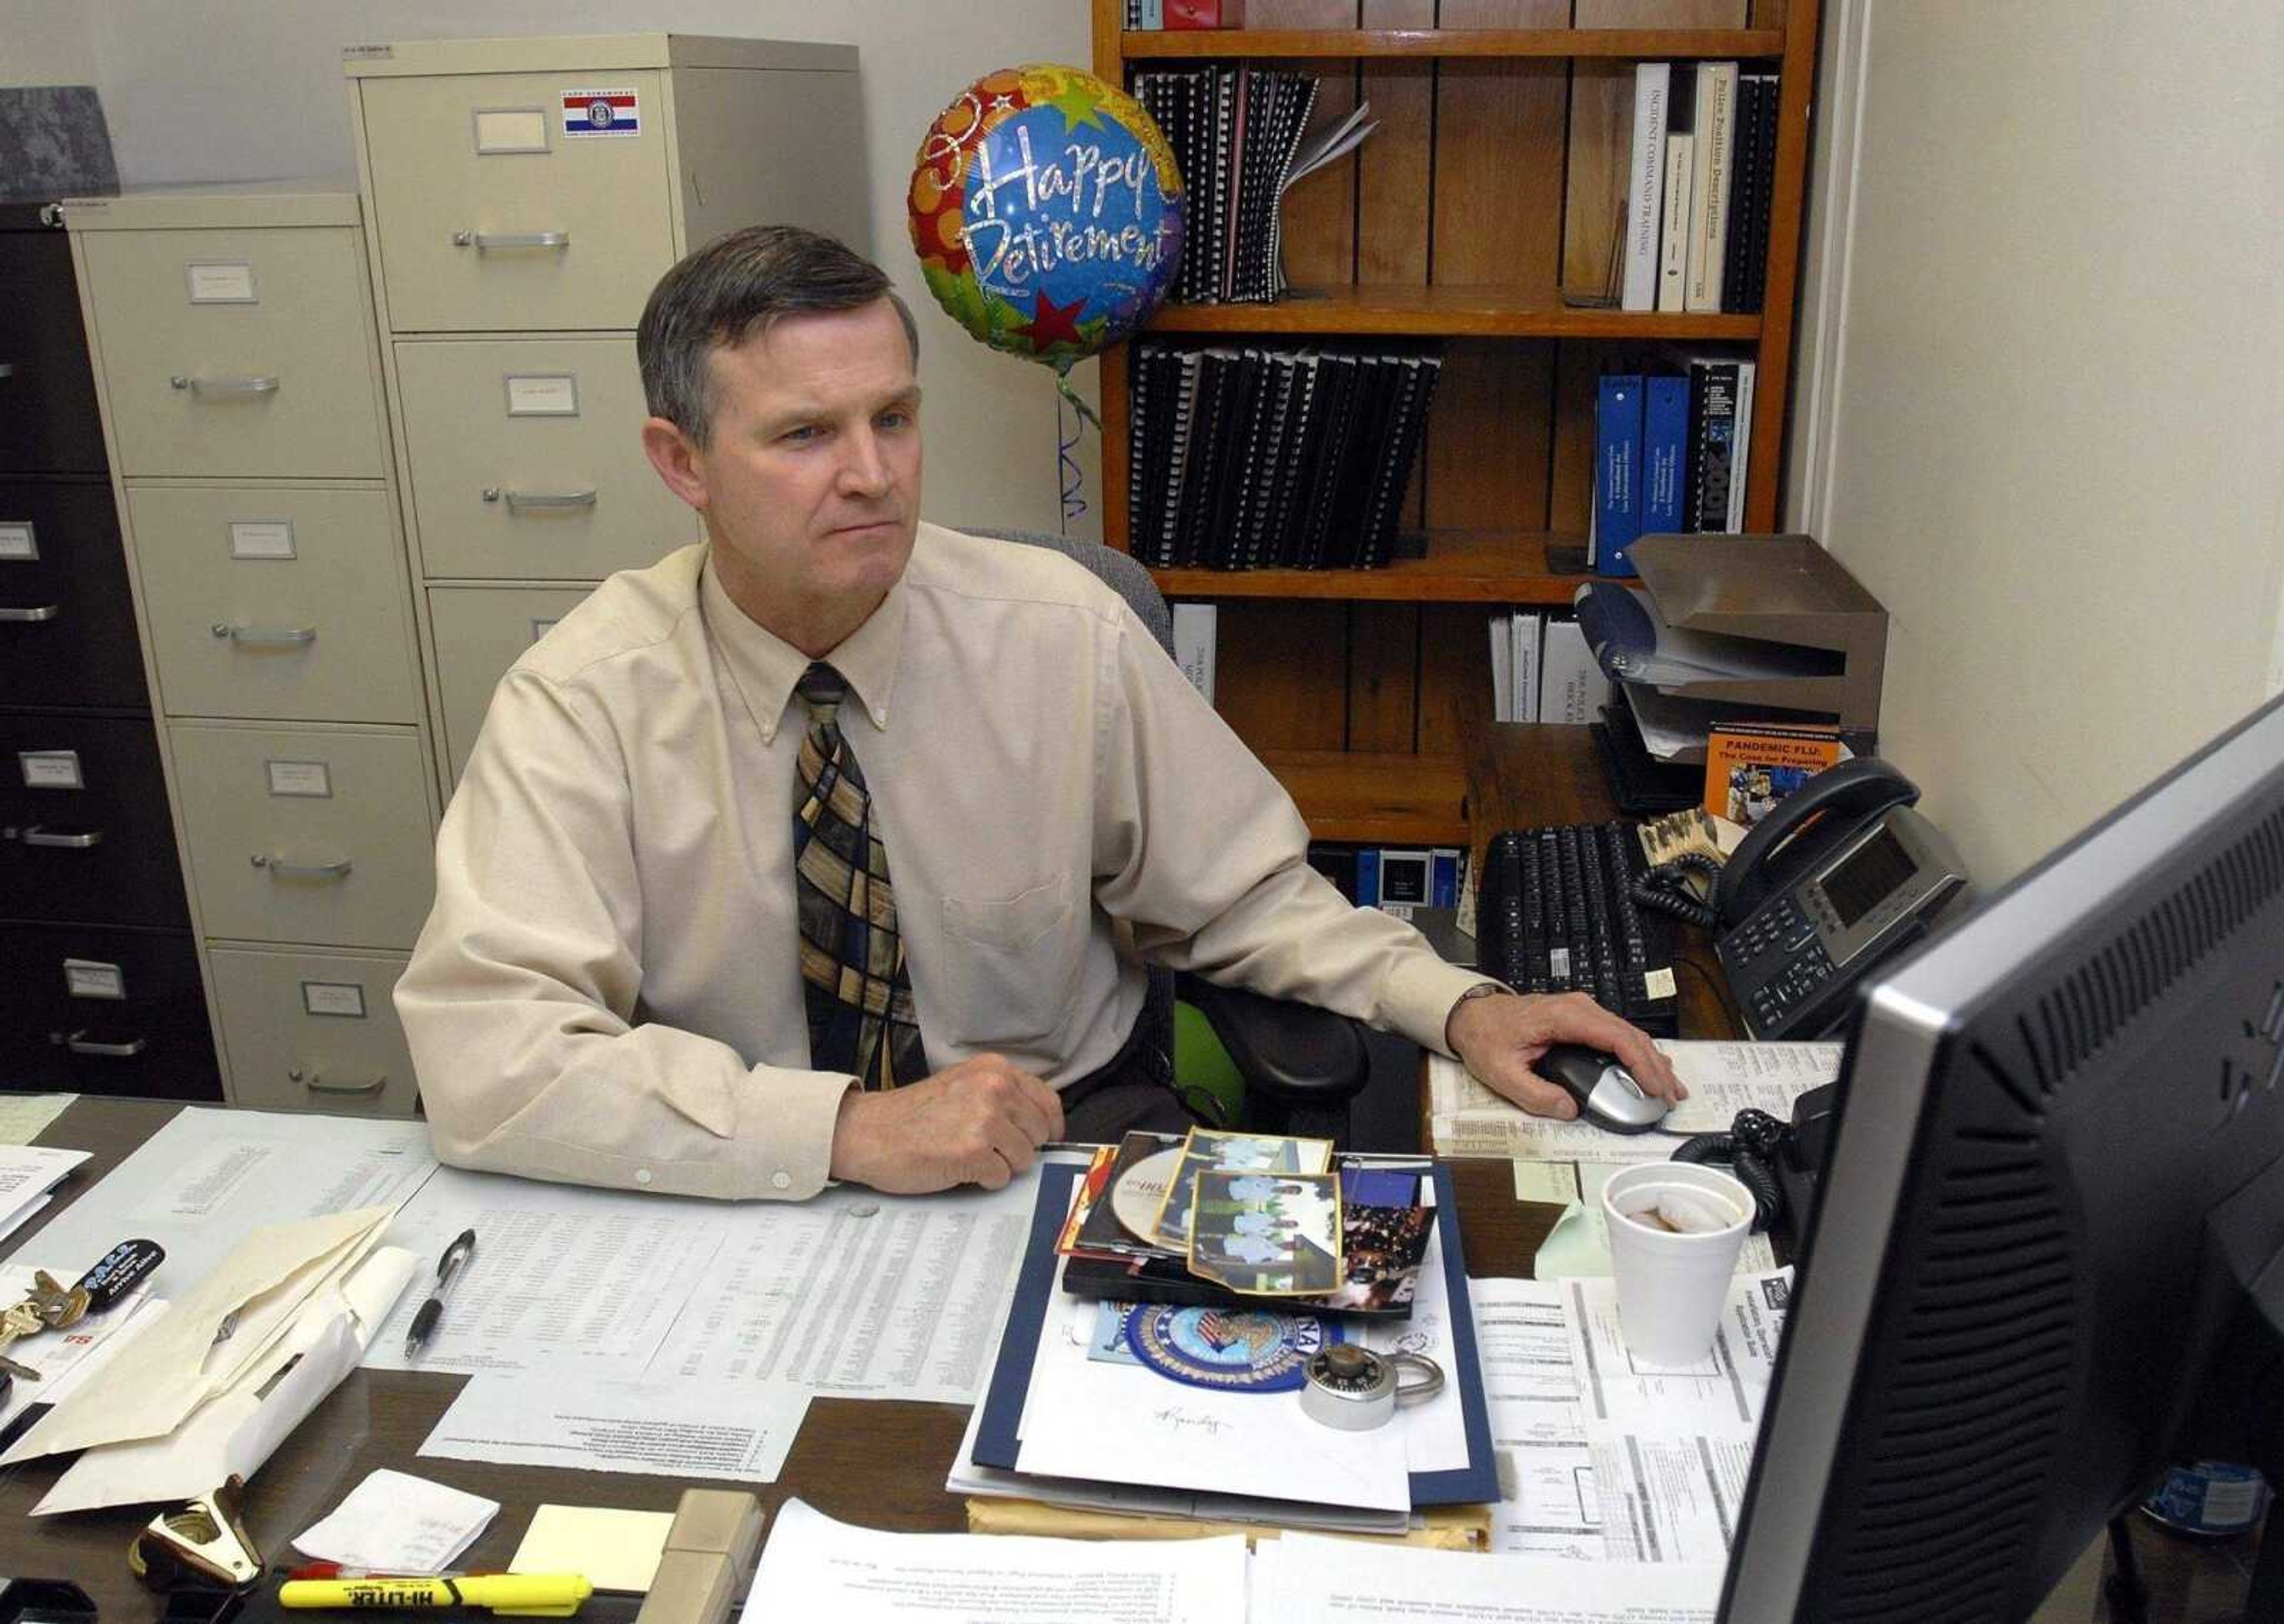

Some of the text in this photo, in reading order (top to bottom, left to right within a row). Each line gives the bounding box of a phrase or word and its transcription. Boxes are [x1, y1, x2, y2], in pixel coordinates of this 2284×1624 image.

[971, 125, 1150, 219] Happy
[1638, 89, 1662, 257] INCIDENT COMMAND TRAINING
[1708, 80, 1727, 240] Police Position Descriptions
[959, 214, 1172, 297] Retirement
[1726, 741, 1822, 755] PANDEMIC FLU:
[1739, 753, 1762, 762] Case
[1781, 756, 1828, 767] Preparing
[108, 1270, 135, 1296] Arrive
[136, 1251, 157, 1270] Alive
[352, 1592, 433, 1606] HI-LITER
